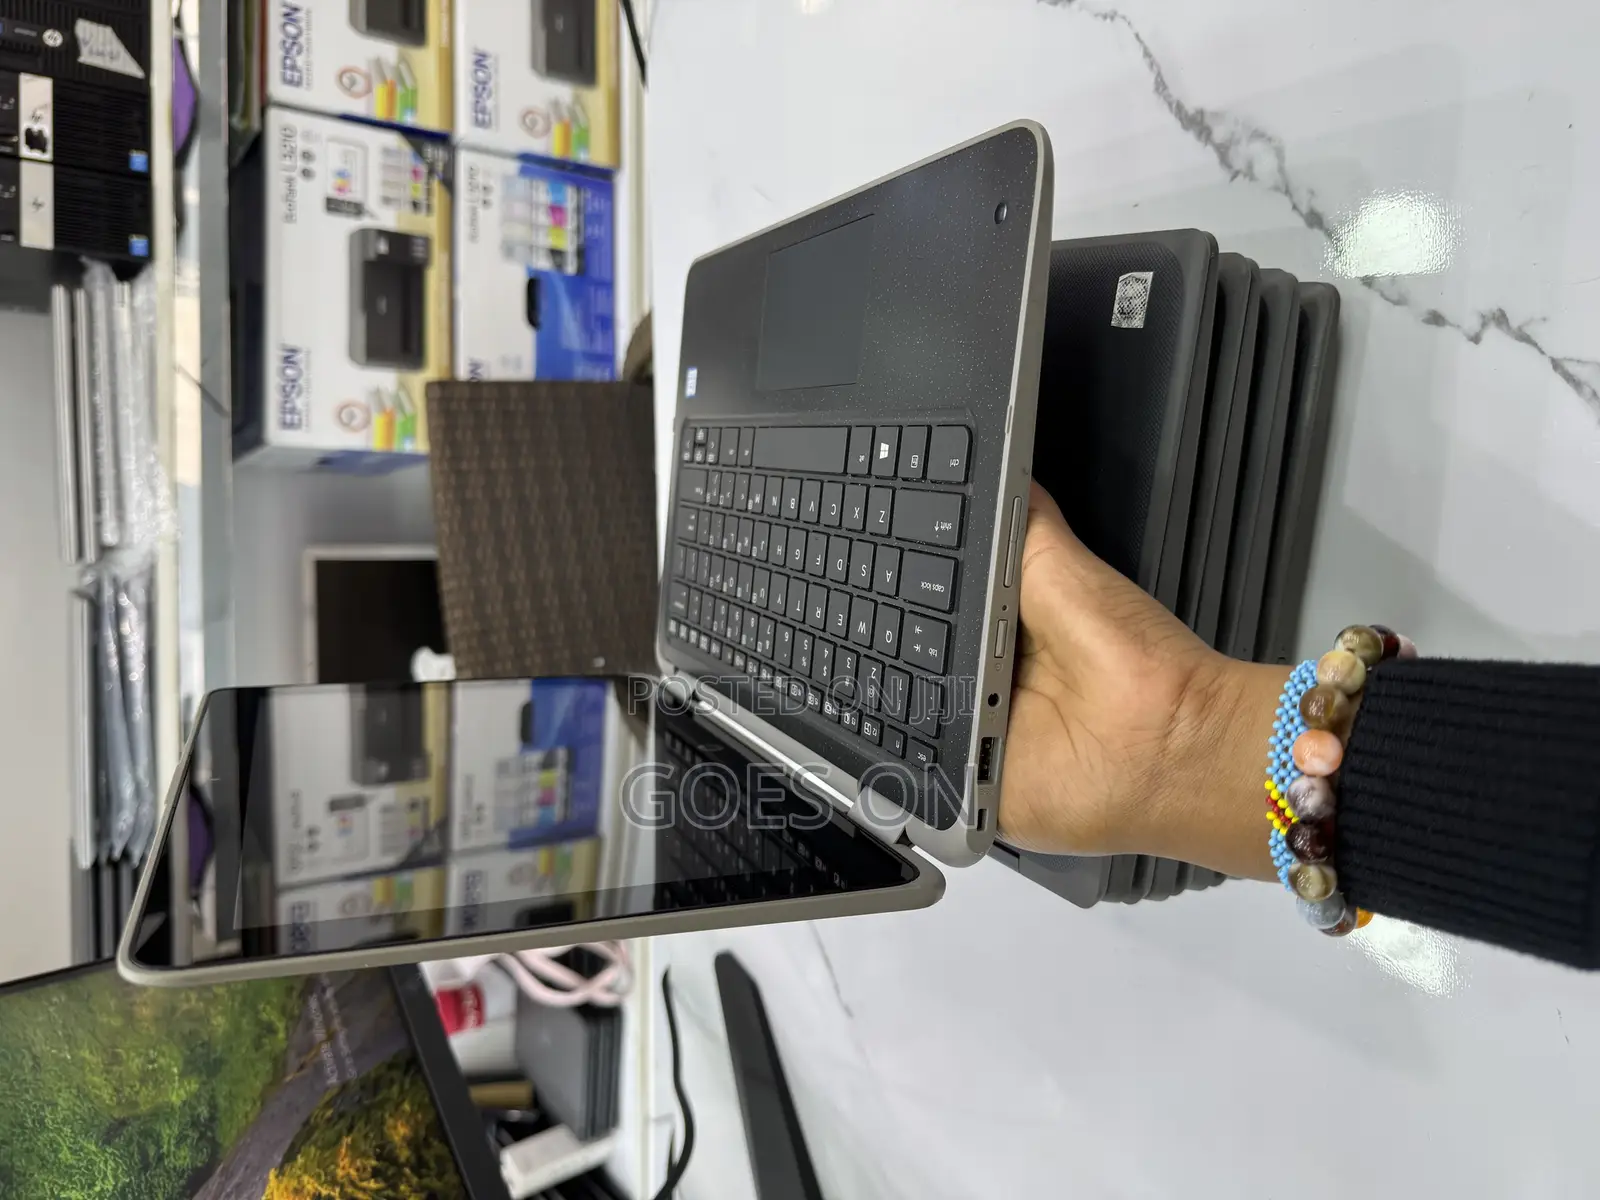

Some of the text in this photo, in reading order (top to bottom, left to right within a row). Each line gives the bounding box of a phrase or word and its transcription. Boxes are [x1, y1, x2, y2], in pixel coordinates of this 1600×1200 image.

[279, 3, 303, 88] EPSON
[469, 47, 492, 129] EPSON
[276, 344, 302, 430] EPSON
[949, 458, 960, 467] ctrl
[831, 503, 837, 515] C
[854, 507, 860, 519] X
[879, 510, 885, 523] Z
[940, 521, 952, 531] shift
[795, 548, 801, 560] G
[836, 559, 843, 571] D
[861, 564, 867, 576] S
[885, 570, 892, 582] A
[920, 581, 944, 593] caps lock
[837, 614, 843, 626] E
[857, 621, 866, 633] W
[885, 630, 892, 643] Q
[928, 647, 937, 658] tab
[871, 667, 877, 678] 2
[918, 752, 926, 762] esc
